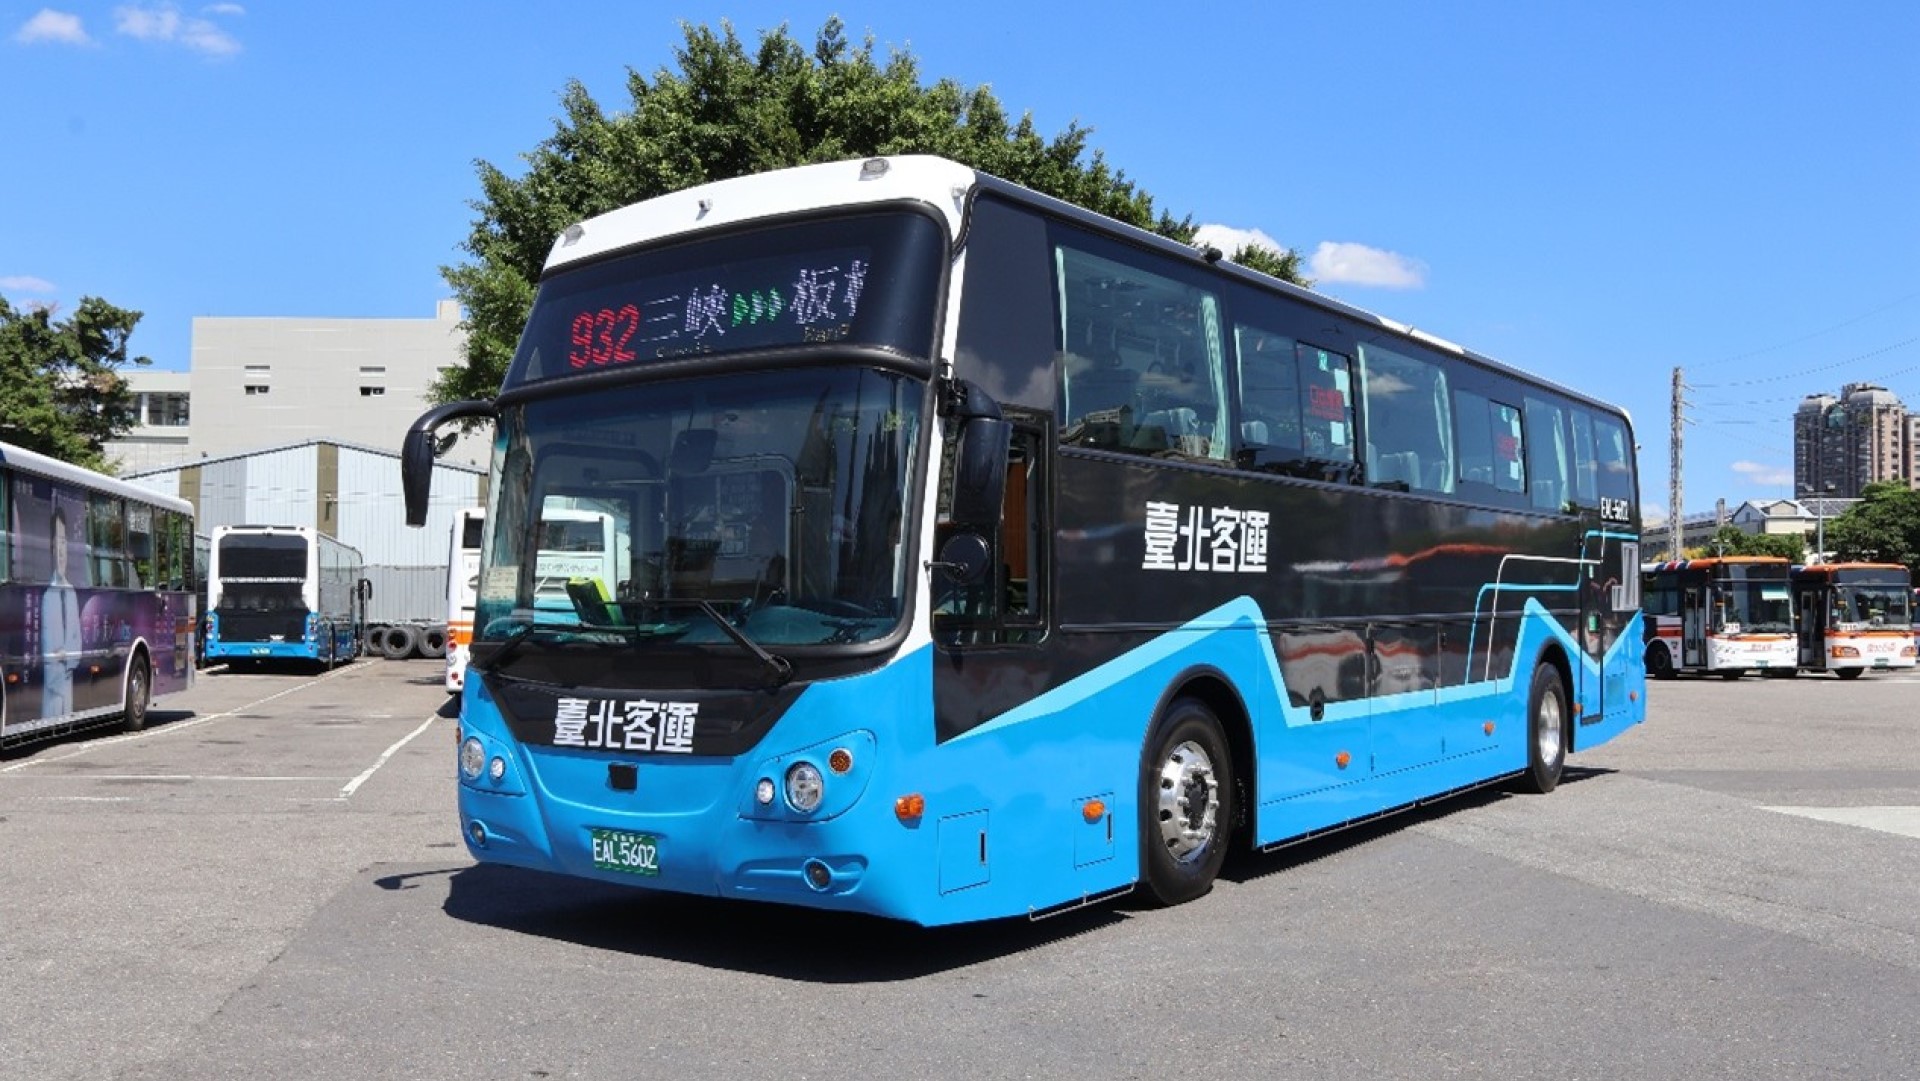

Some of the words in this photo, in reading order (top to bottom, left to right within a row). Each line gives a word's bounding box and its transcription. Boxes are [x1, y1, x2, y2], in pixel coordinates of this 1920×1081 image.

[570, 303, 640, 369] 932
[640, 283, 728, 341] 三峽
[1142, 501, 1270, 573] 臺北客運
[552, 697, 699, 754] 臺北客運
